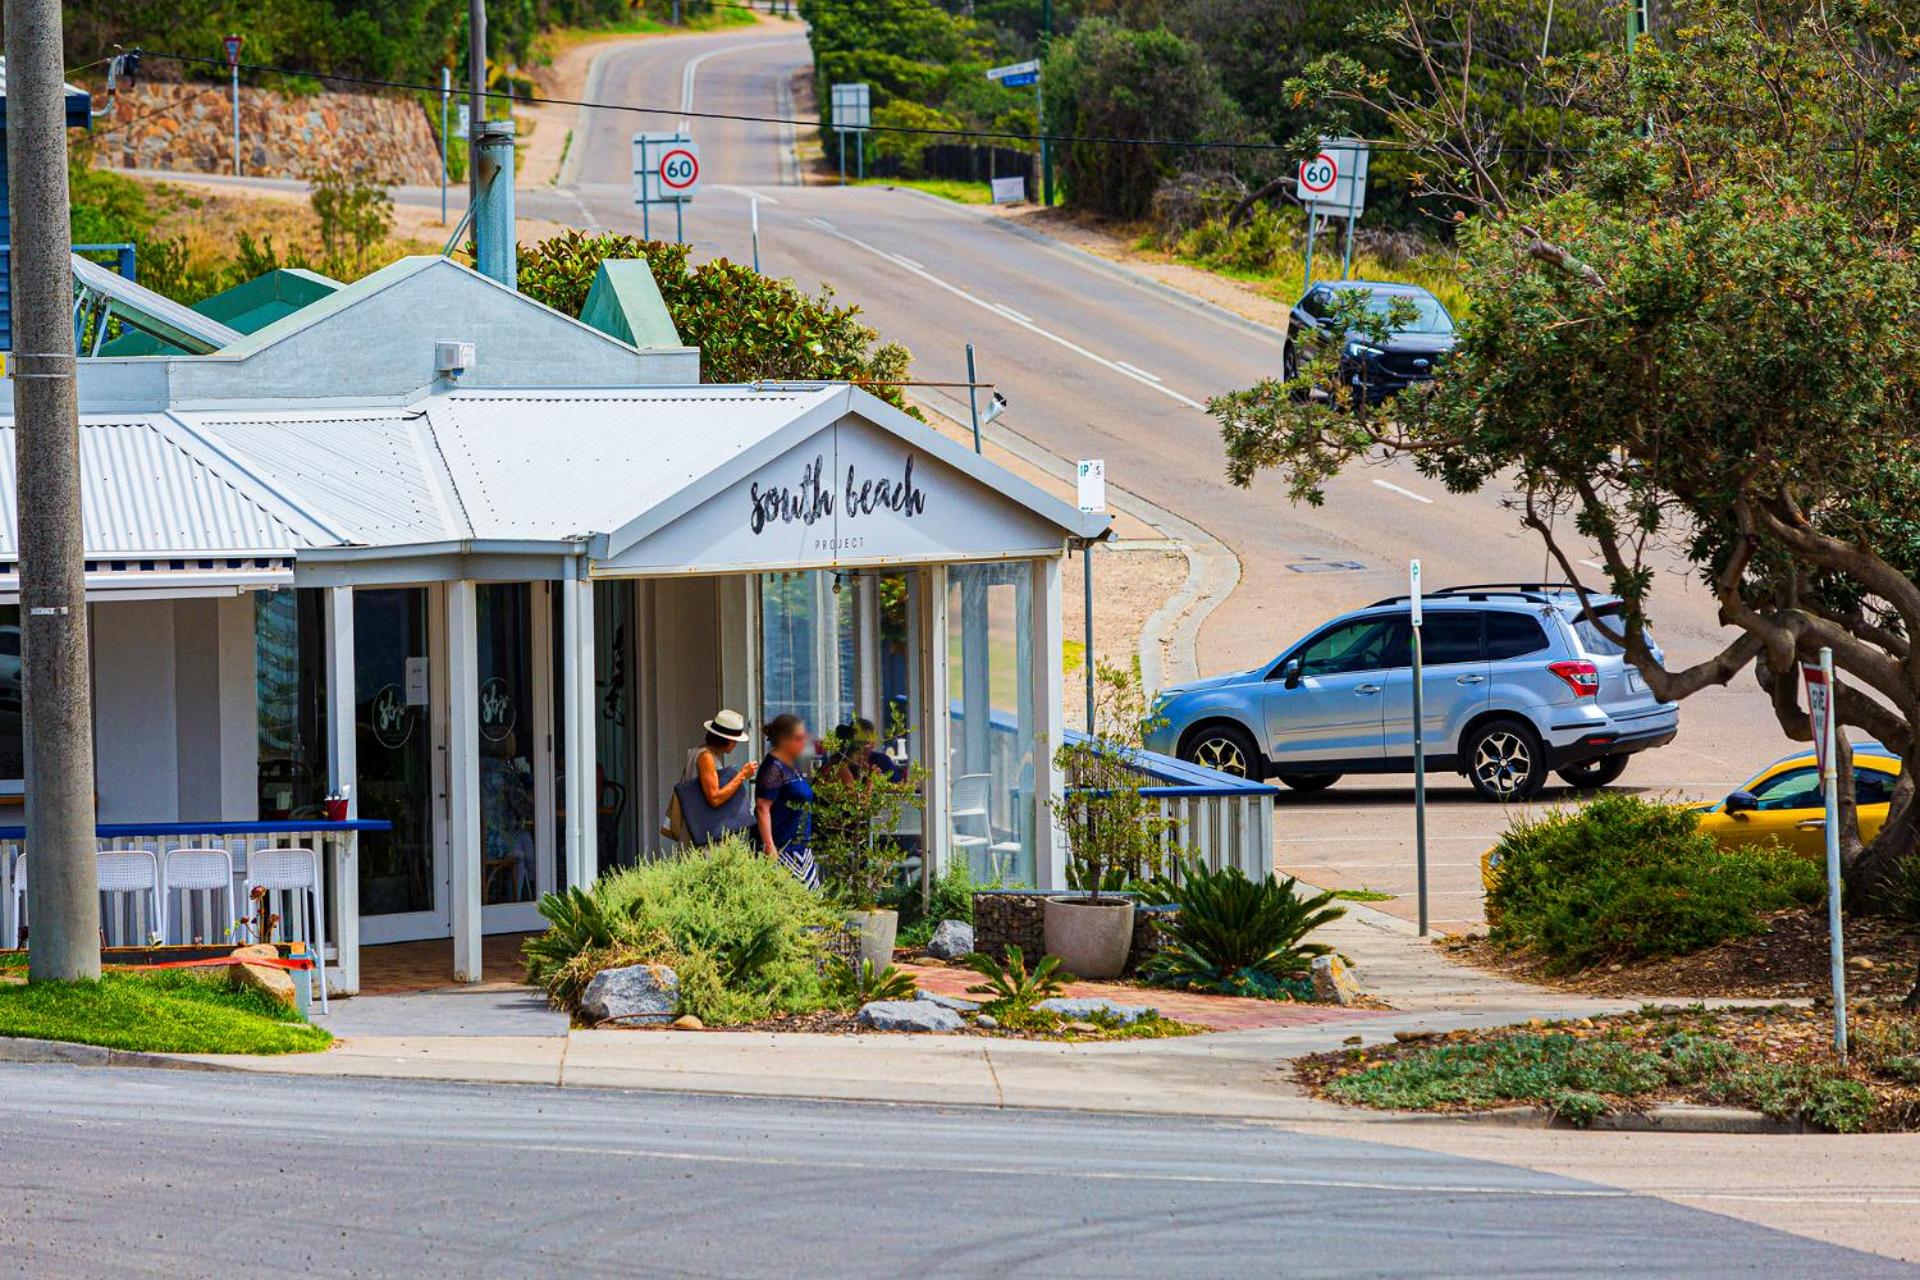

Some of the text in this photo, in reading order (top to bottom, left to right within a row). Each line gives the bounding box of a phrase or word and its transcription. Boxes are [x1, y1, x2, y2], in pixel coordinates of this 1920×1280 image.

[667, 160, 692, 178] 60
[1307, 166, 1331, 184] 60
[750, 453, 926, 535] south beach
[815, 537, 864, 550] PROJECT
